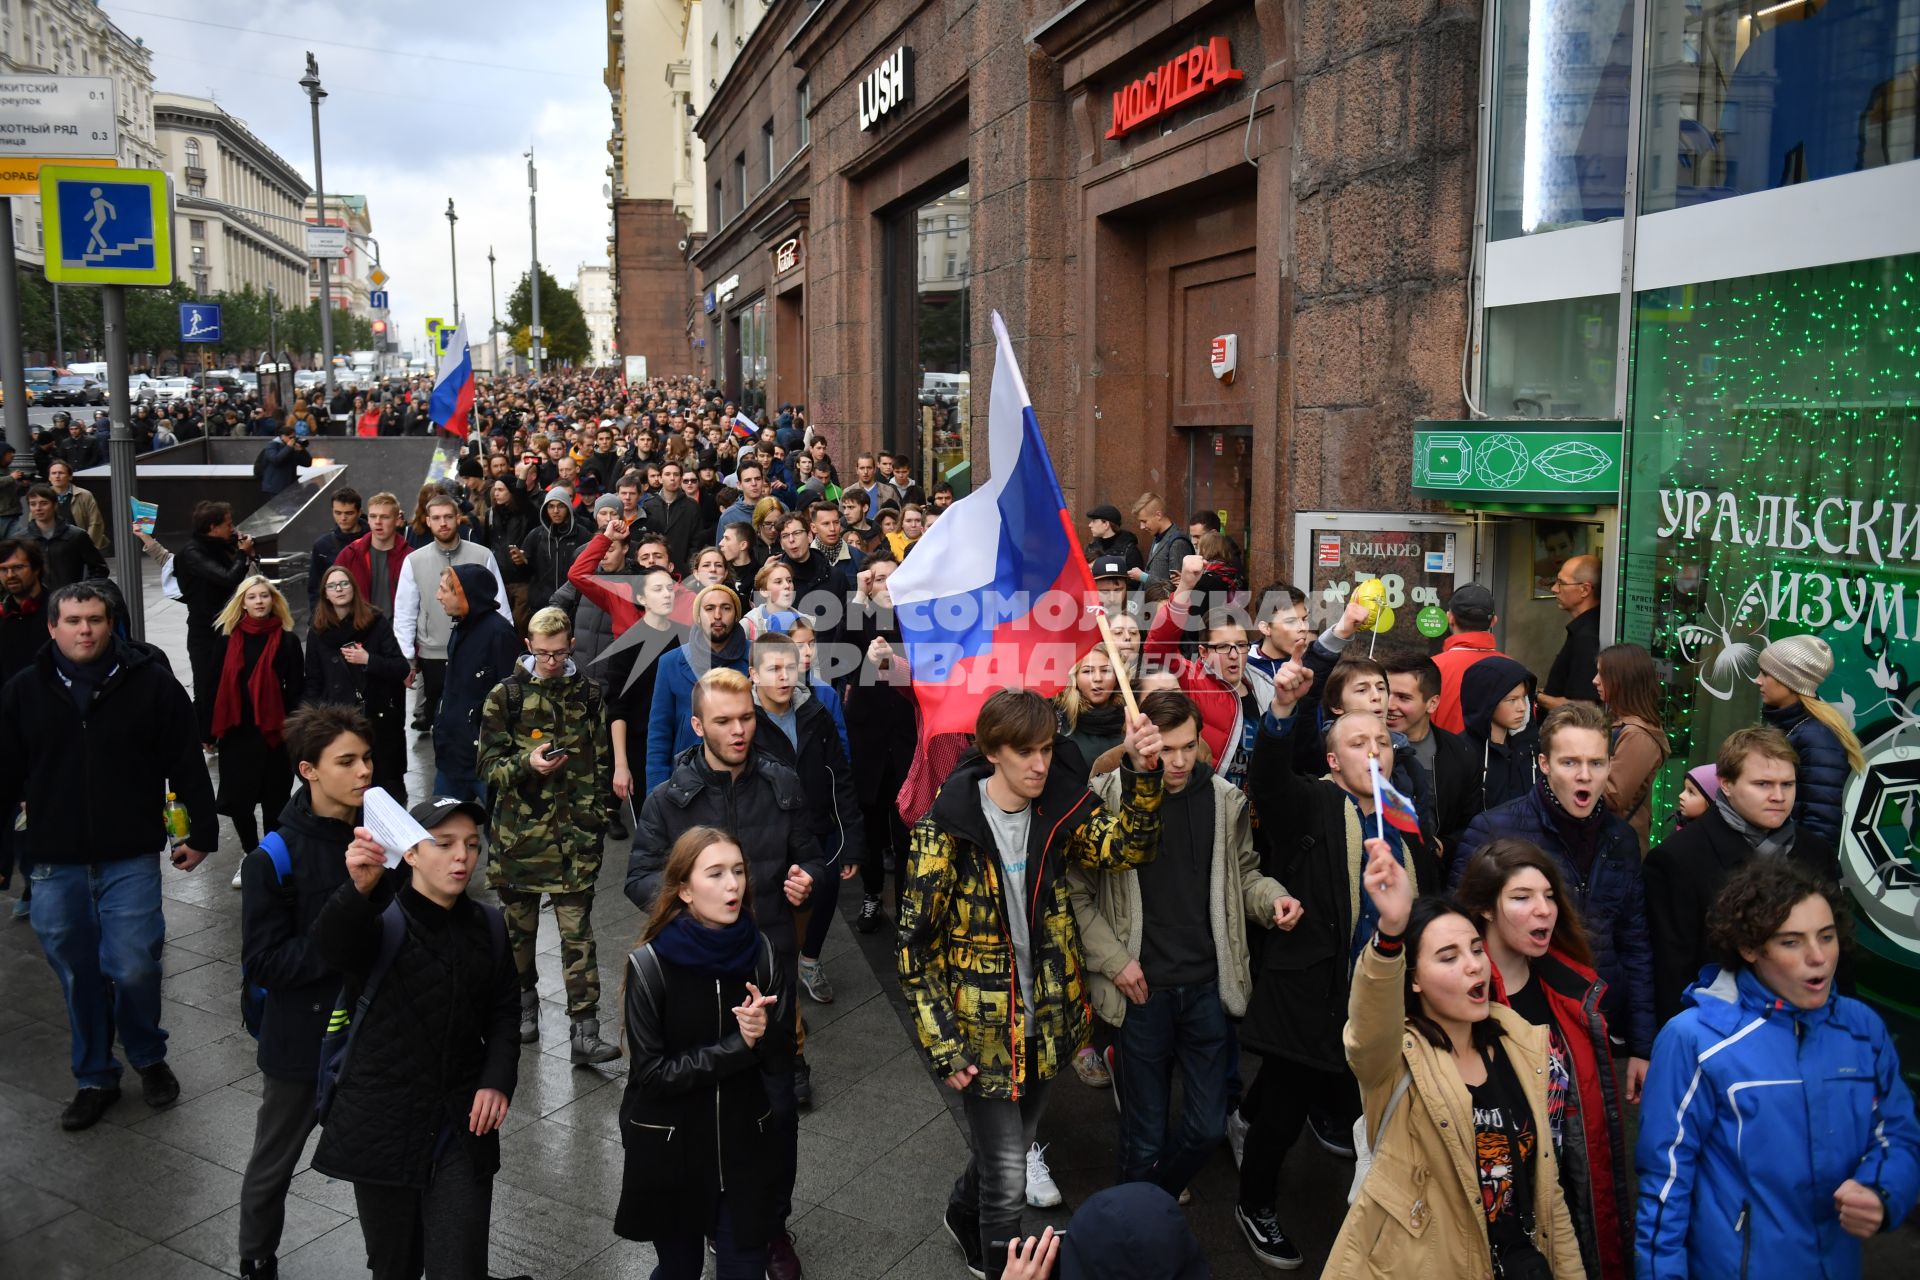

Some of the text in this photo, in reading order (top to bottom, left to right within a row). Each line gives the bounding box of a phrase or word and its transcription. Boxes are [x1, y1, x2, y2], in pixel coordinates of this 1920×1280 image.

[858, 45, 905, 132] LUSH
[1104, 36, 1231, 139] МОСИГРА
[89, 91, 105, 100] 0.1
[54, 125, 78, 135] РЯД
[91, 131, 108, 141] 0.3
